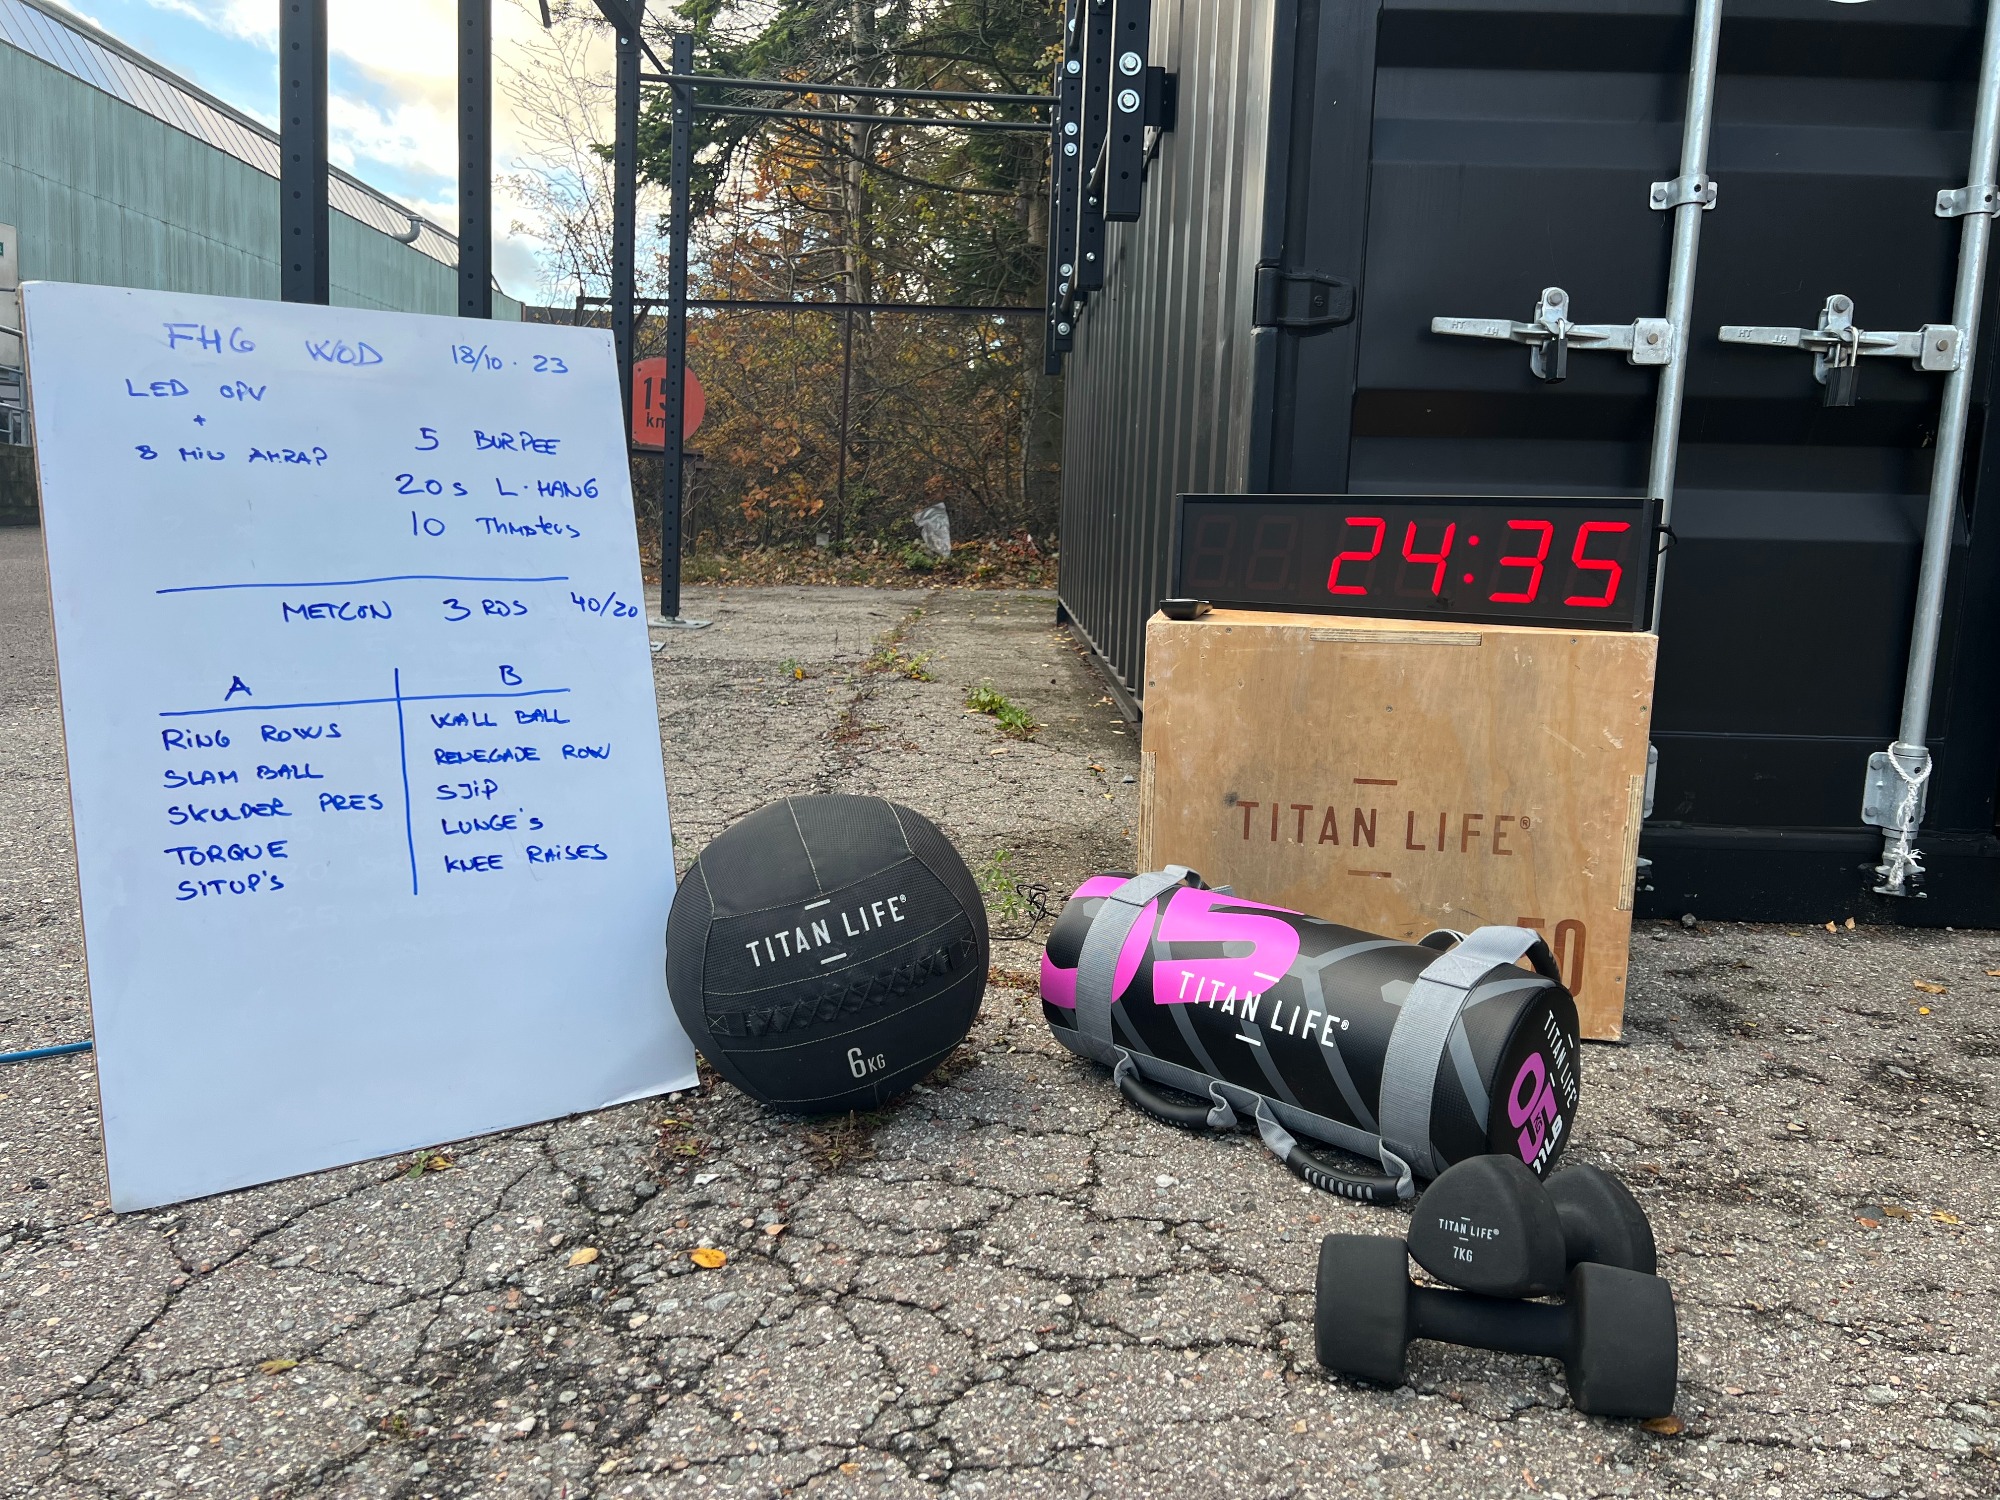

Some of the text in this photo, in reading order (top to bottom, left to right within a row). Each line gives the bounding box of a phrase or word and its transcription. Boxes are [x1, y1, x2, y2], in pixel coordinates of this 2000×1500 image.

[305, 339, 385, 367] WOD
[125, 378, 190, 398] LED
[134, 444, 159, 461] 8
[414, 426, 561, 456] 5 BURPEE
[411, 510, 446, 537] 10
[1327, 516, 1631, 608] 24:35
[282, 591, 639, 623] METCON 3 RDS 40/20
[223, 675, 253, 702] A
[498, 664, 524, 687] B
[260, 722, 342, 743] ROWS
[430, 708, 571, 730] WALL BALL
[433, 742, 611, 766] RENEGADE ROW
[162, 762, 325, 789] SLAM BALL
[318, 792, 384, 813] PRES
[1236, 800, 1378, 848] TITAN
[163, 839, 289, 867] TORQUE
[443, 854, 504, 874] KNEE
[745, 918, 832, 968] TITAN
[1178, 970, 1263, 1024] TITAN
[1543, 1009, 1568, 1070] TITAN
[1438, 1218, 1467, 1235] TITAN
[1453, 1245, 1473, 1263] 7KG
